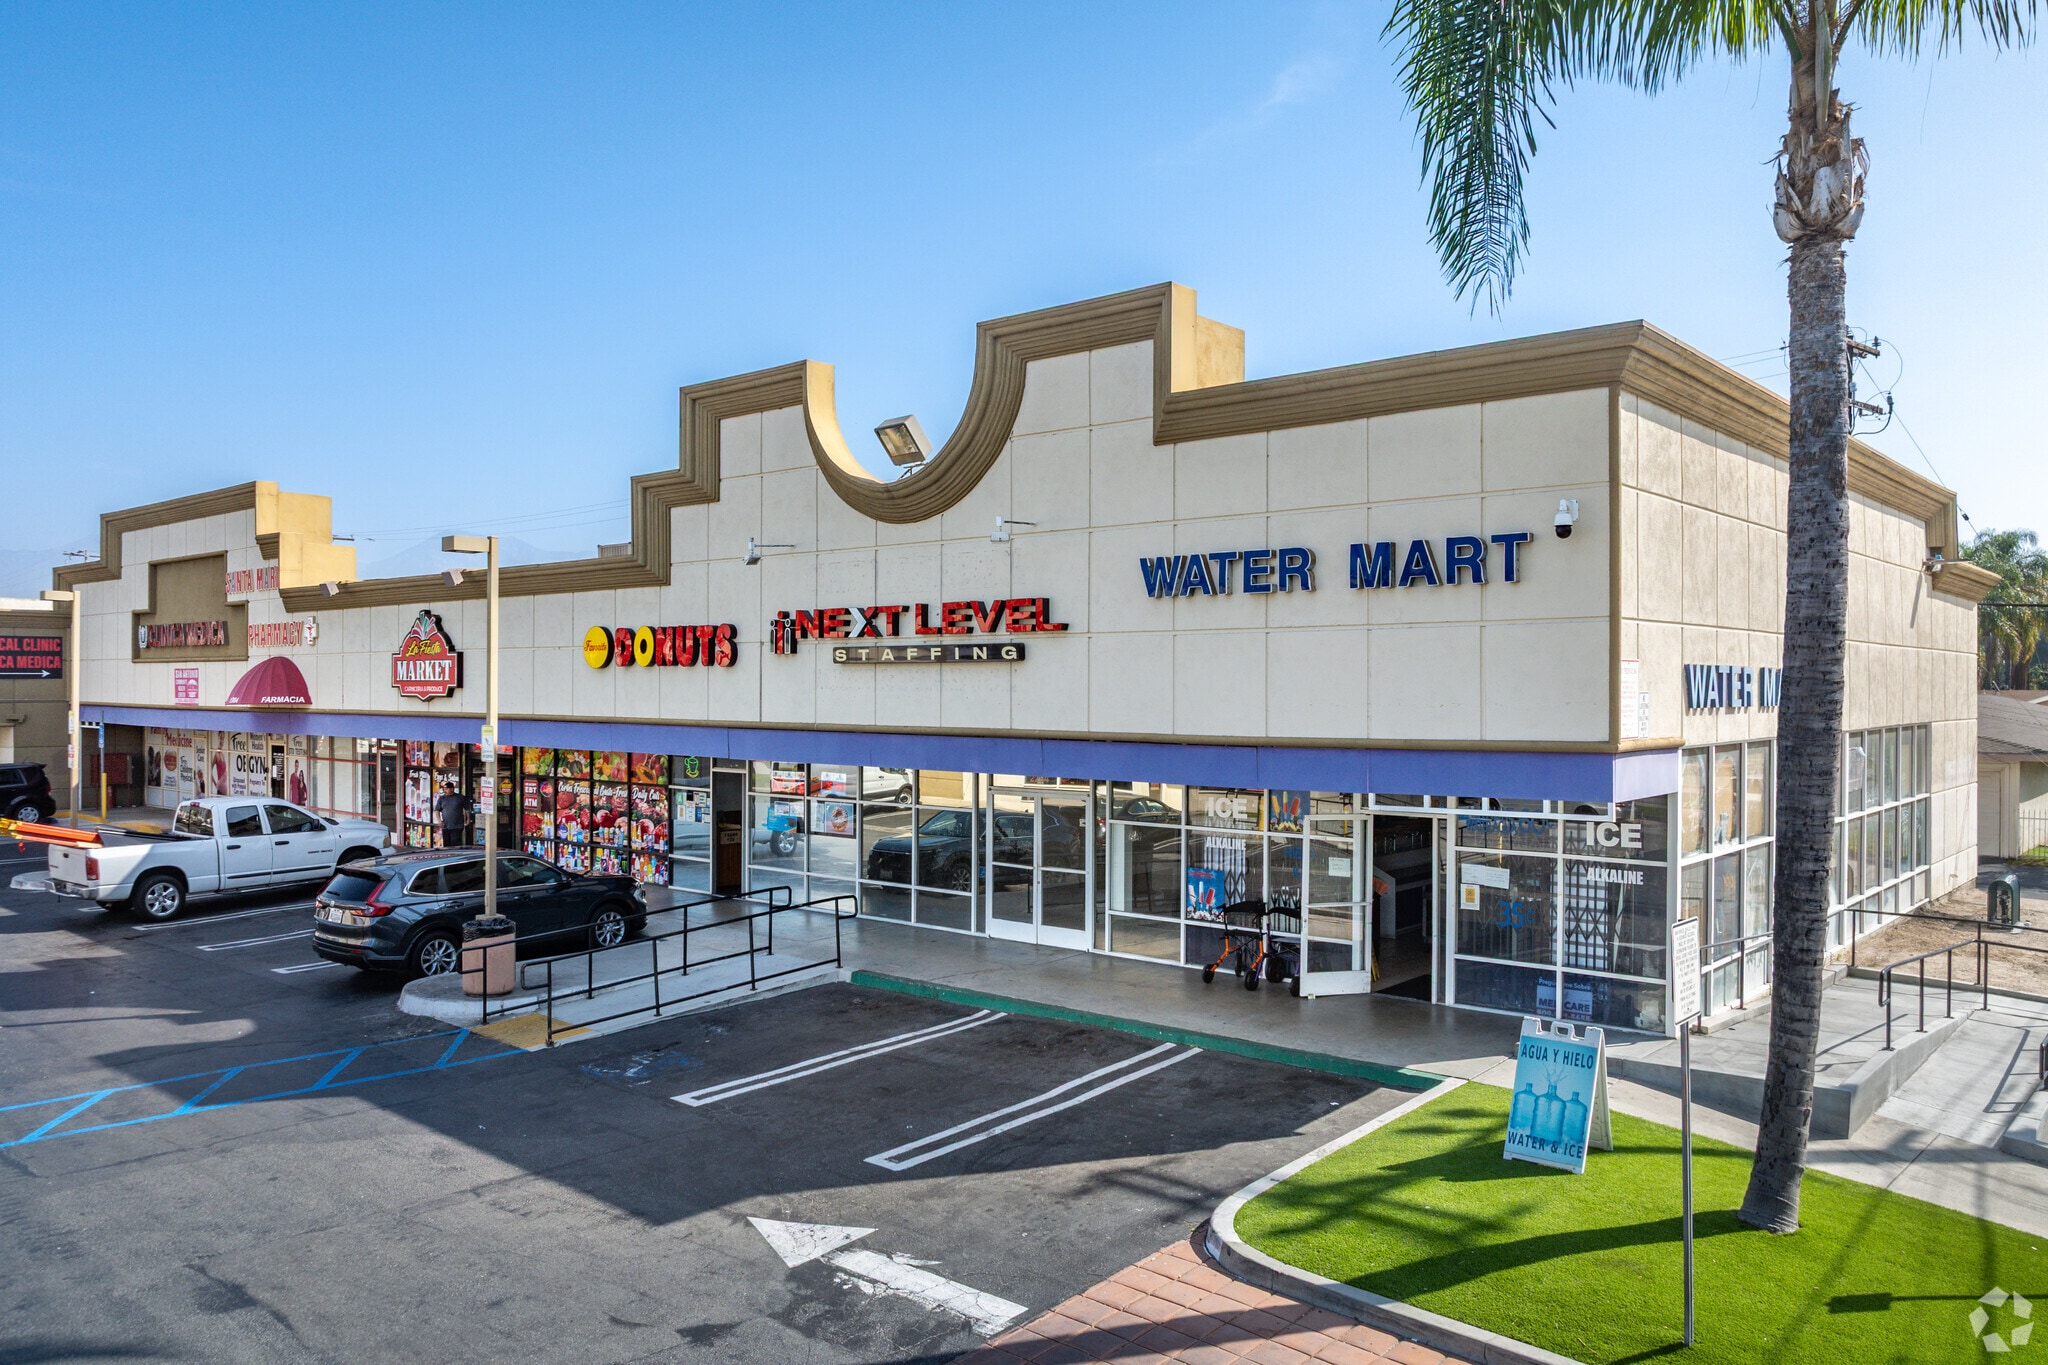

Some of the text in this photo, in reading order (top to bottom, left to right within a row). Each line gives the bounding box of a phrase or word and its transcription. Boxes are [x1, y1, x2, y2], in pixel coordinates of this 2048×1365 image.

[1139, 532, 1534, 598] WATER MART
[226, 570, 251, 594] SANTA
[795, 598, 1069, 639] NEXT LEVEL
[0, 637, 61, 651] CAL CLINIC
[149, 621, 226, 647] CLINICA MEDICA
[248, 621, 303, 648] PHARMACY
[406, 640, 441, 657] La Fiesta
[584, 640, 607, 652] Favorite
[615, 624, 737, 667] DONUTS
[835, 646, 1018, 662] STAFFING
[0, 655, 61, 669] CA MEDICA
[396, 660, 452, 681] MARKET
[1684, 664, 1753, 709] WATER
[231, 732, 246, 751] Free
[525, 798, 538, 807] ATM
[632, 787, 647, 800] Daily
[1207, 796, 1248, 819] ICE
[1206, 837, 1247, 850] ALKALINE
[1586, 821, 1643, 849] ICE
[1586, 867, 1644, 886] ALKALINE
[1521, 1043, 1594, 1070] AGUA Y HIELO
[1508, 1130, 1583, 1159] WATER & ICE
